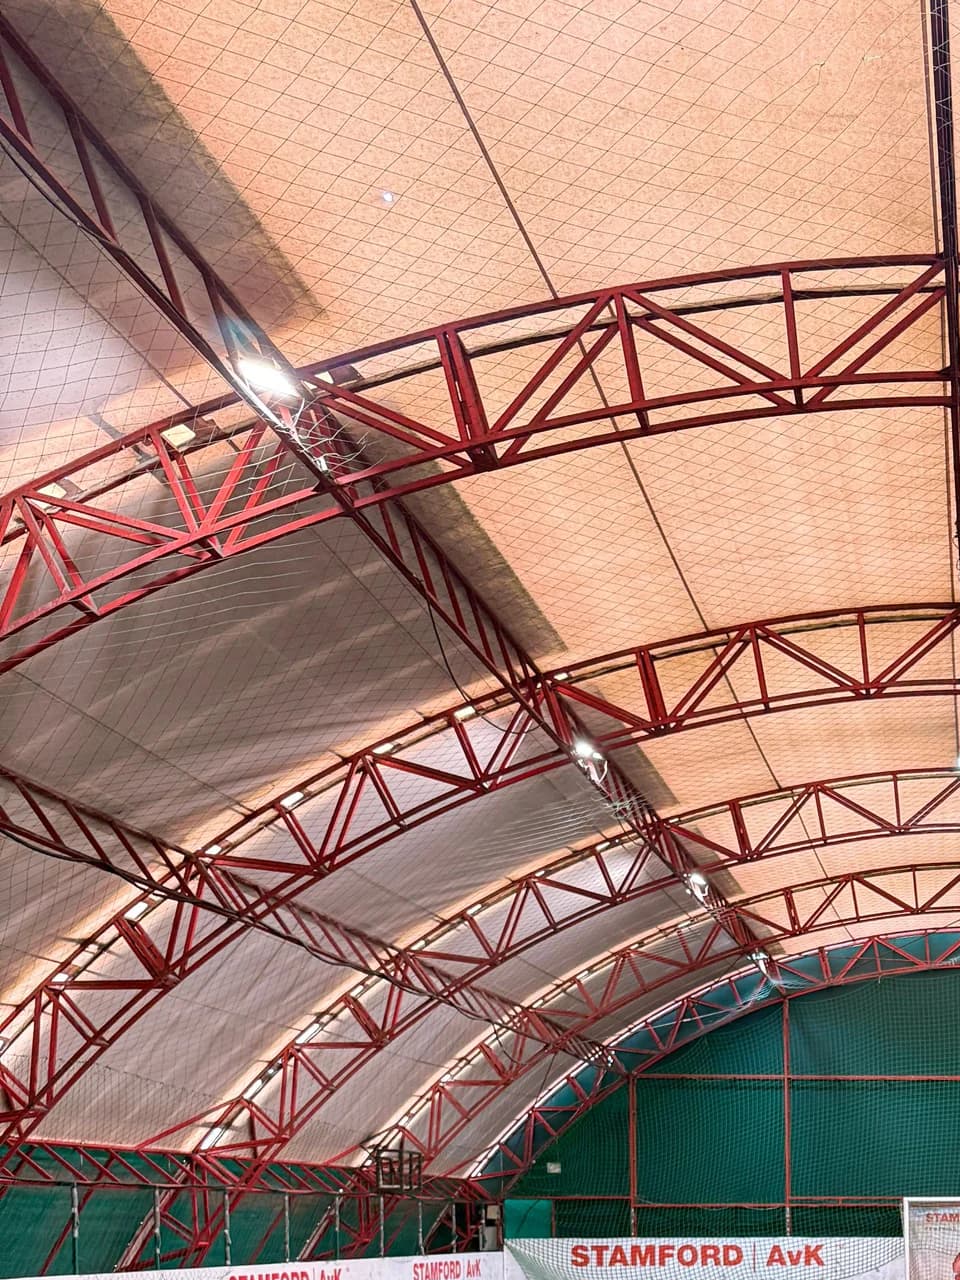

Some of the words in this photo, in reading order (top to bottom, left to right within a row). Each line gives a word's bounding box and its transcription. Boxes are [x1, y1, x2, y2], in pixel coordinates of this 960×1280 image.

[571, 1244, 744, 1267] STAMFORD
[766, 1244, 825, 1267] AvK
[466, 1258, 481, 1278] AvK
